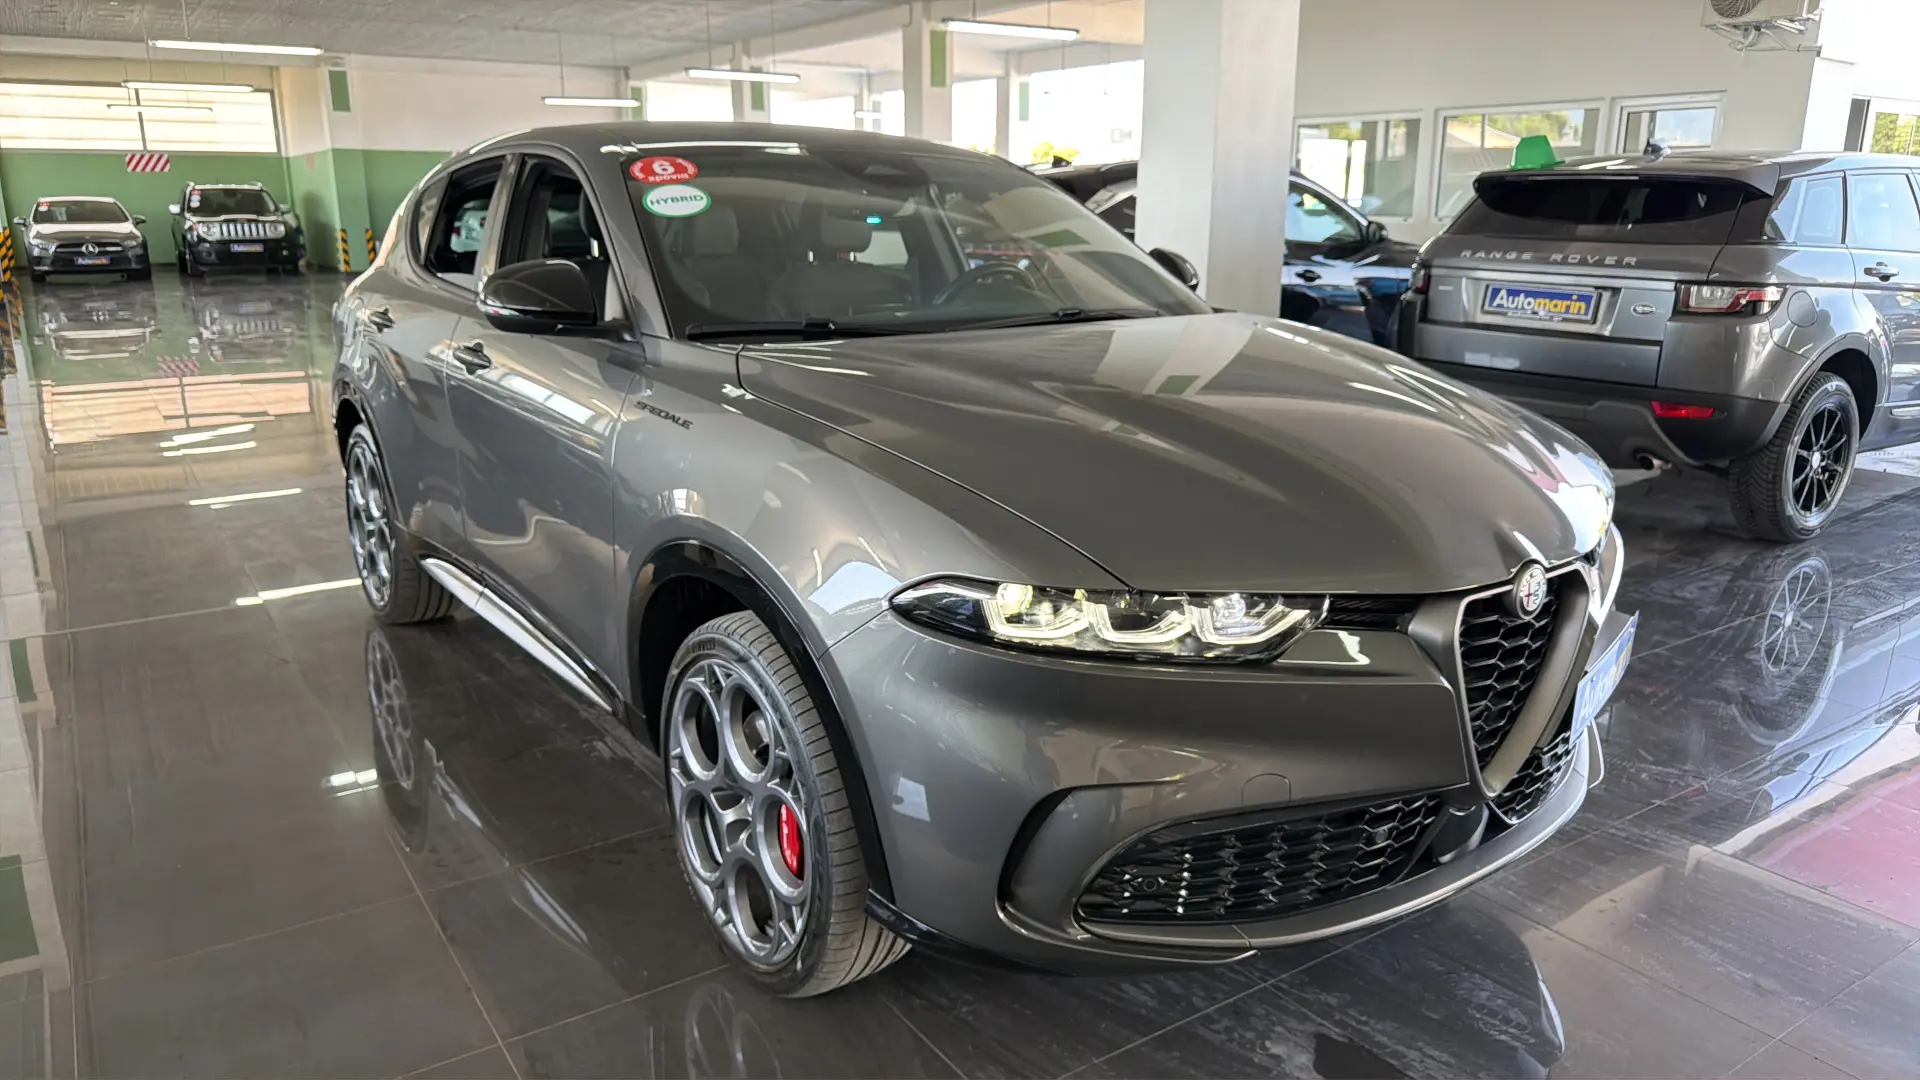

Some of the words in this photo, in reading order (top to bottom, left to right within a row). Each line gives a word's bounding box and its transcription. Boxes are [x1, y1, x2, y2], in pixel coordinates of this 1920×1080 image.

[652, 160, 675, 176] 6
[649, 194, 704, 206] HYBRID
[1460, 250, 1534, 260] RANGE
[1549, 252, 1638, 266] ROVER
[1492, 287, 1587, 315] Automarin
[633, 400, 694, 431] SPECIALE
